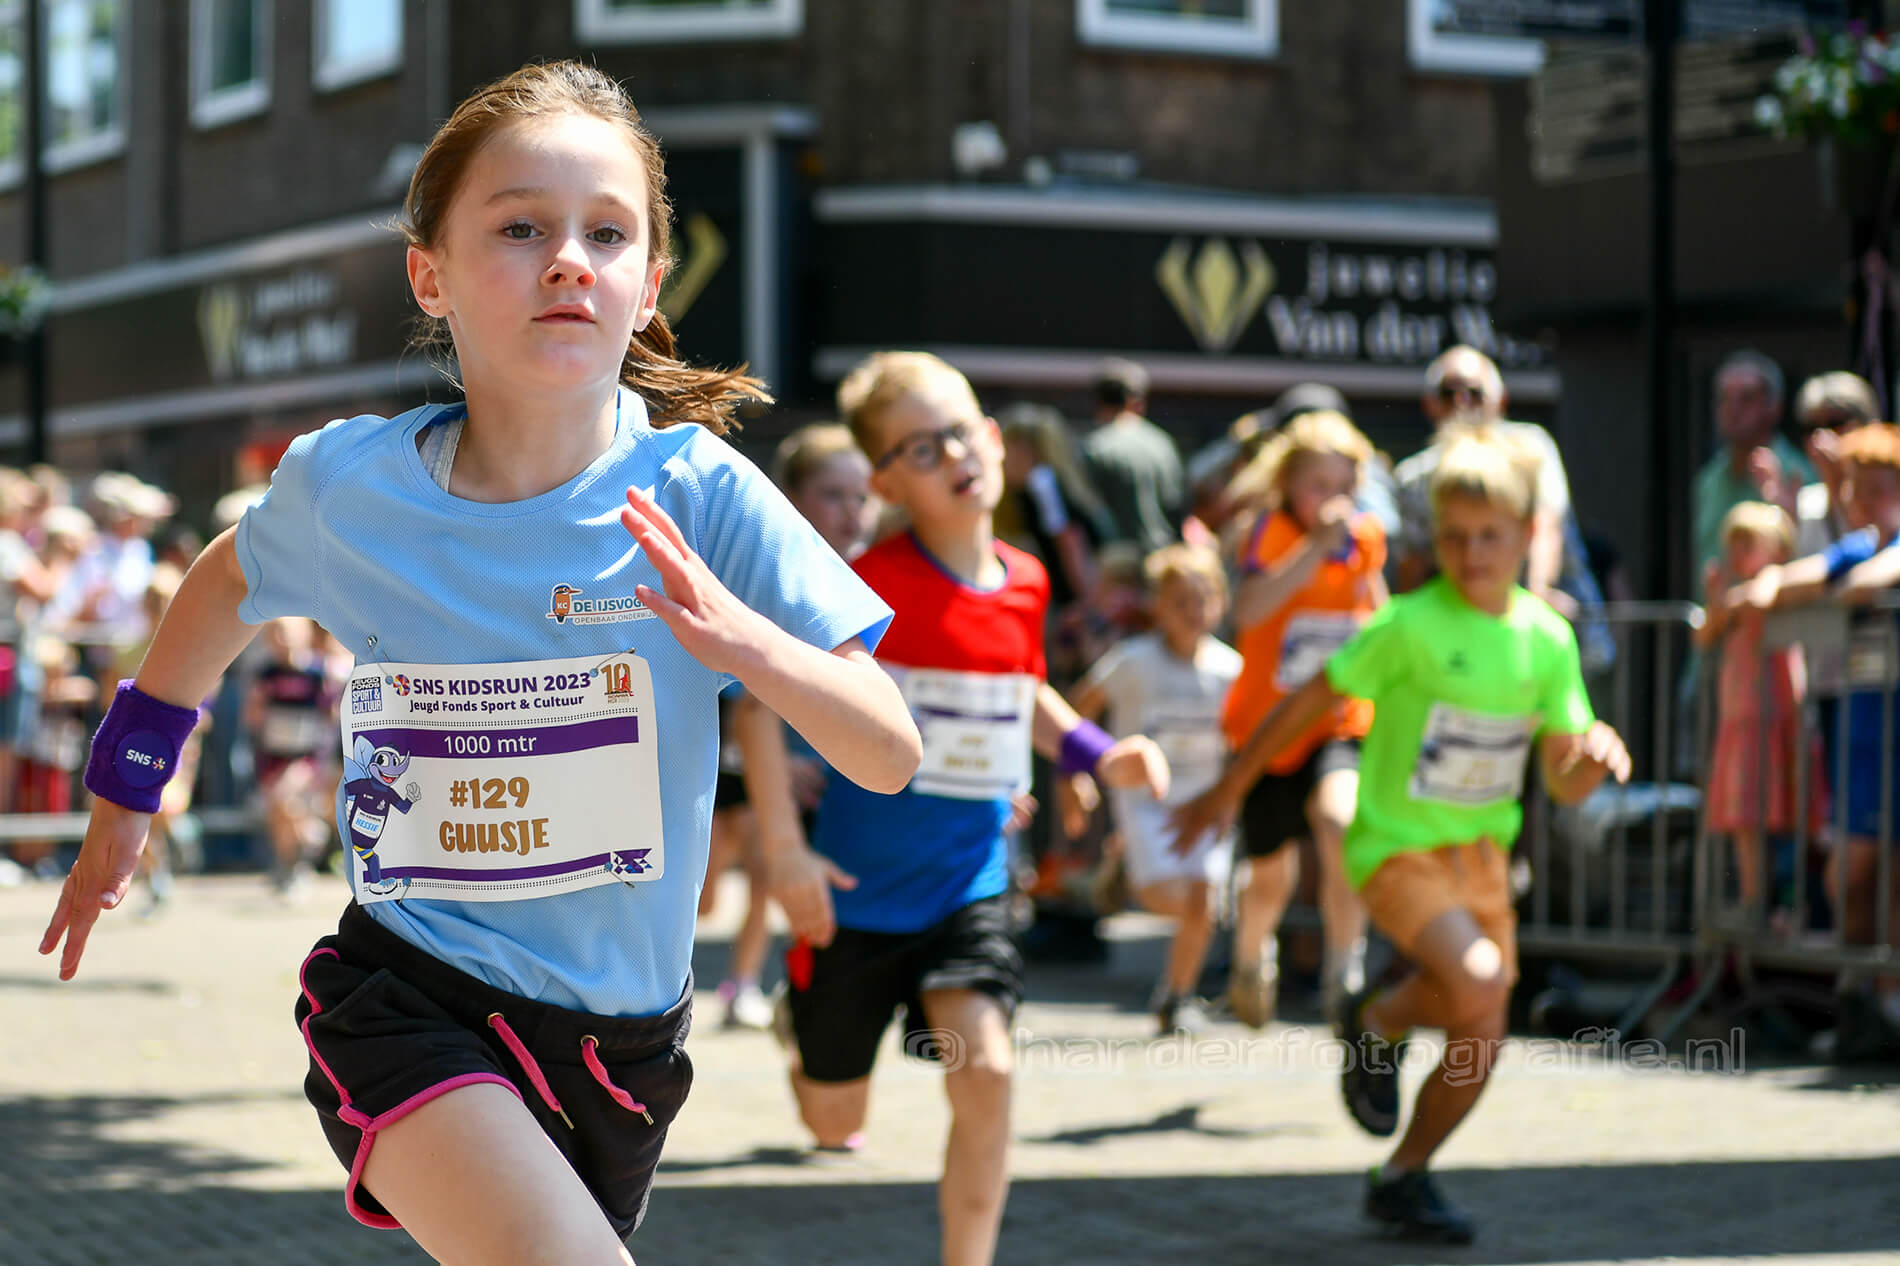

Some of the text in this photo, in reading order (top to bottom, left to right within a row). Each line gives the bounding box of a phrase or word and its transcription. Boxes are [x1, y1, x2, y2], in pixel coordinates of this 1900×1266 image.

[574, 601, 592, 613] DE
[574, 611, 657, 624] OPENBAAR ONDERWIJS
[413, 672, 591, 696] SNS KIDSRUN 2023
[353, 688, 381, 702] SPORT &
[353, 700, 382, 713] CULTUUR
[410, 695, 585, 714] Jeugd Fonds Sport & Cultuur
[444, 735, 537, 754] 1000 mtr
[126, 749, 152, 766] SNS
[449, 776, 530, 809] #129
[439, 818, 550, 856] GUUSJE
